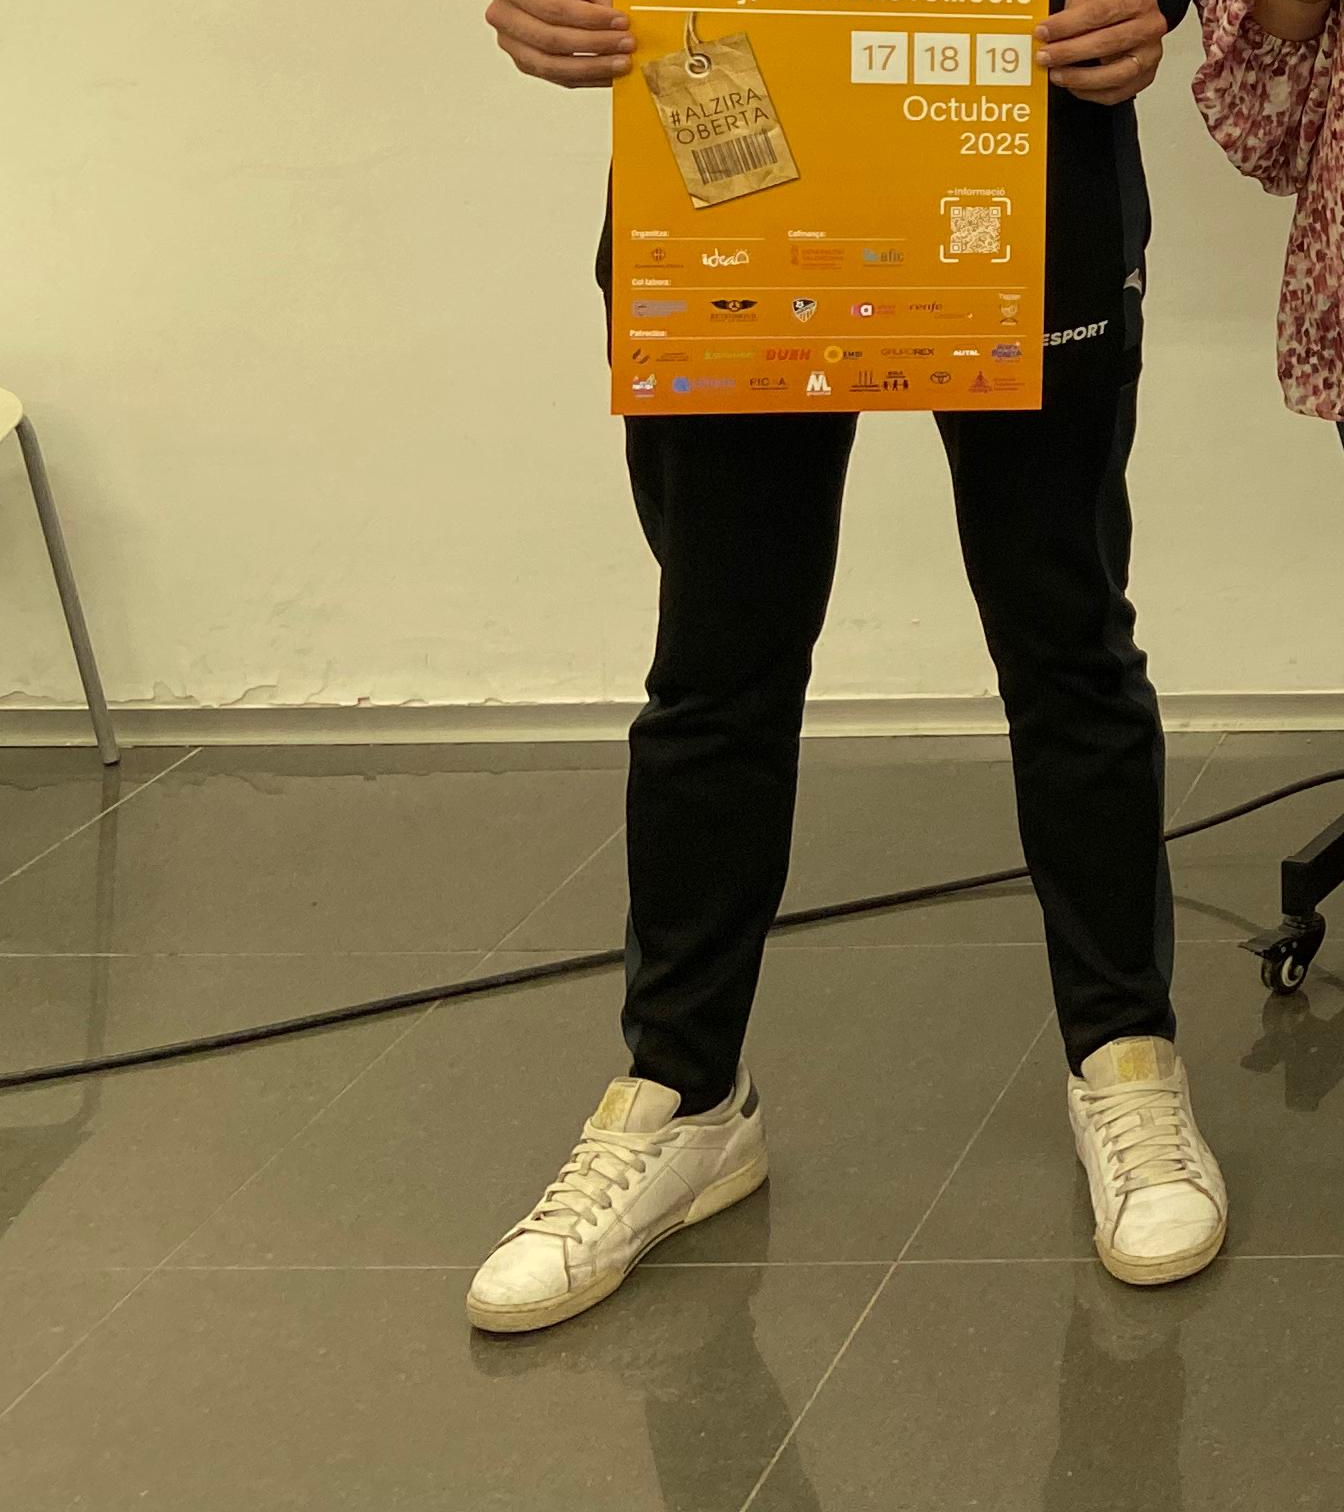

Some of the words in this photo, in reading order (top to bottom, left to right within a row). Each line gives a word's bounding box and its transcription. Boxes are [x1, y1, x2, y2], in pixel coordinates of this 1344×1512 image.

[863, 45, 896, 71] 17
[924, 46, 959, 71] 18
[986, 48, 1019, 72] 19
[670, 89, 762, 125] #ALZIRA
[904, 96, 1030, 122] Octubre
[677, 108, 769, 144] OBERTA
[960, 133, 1029, 155] 2025
